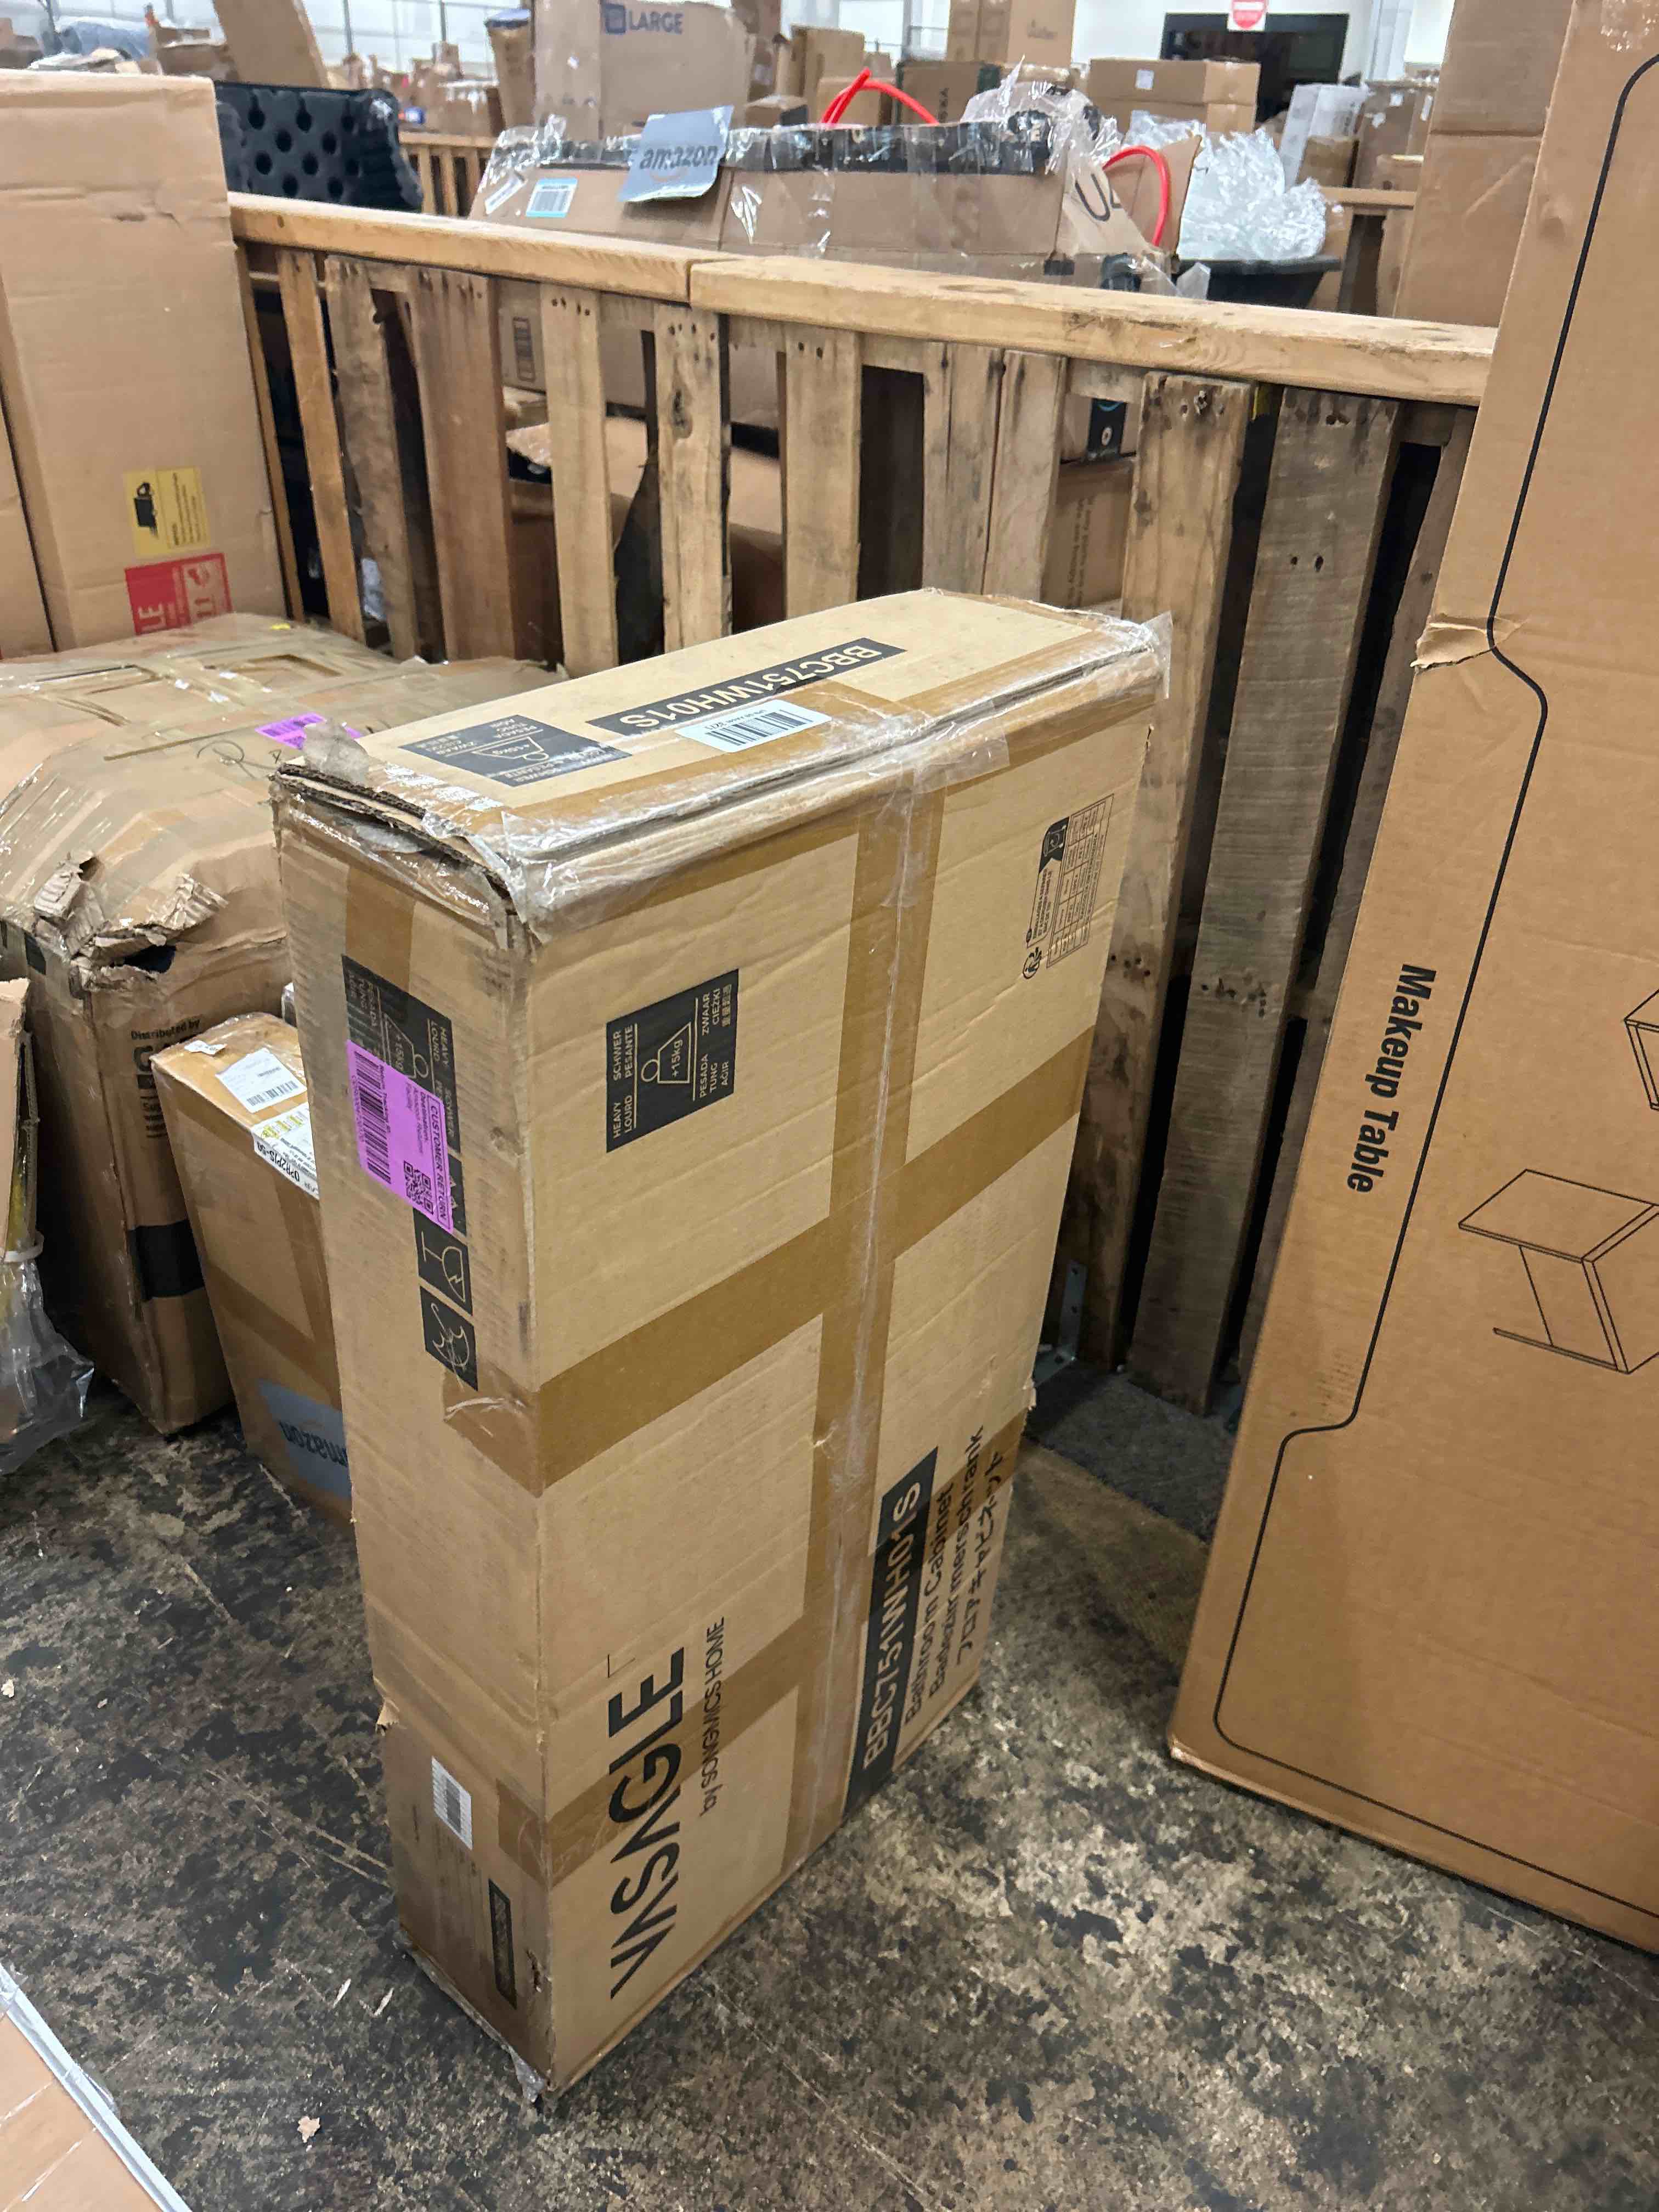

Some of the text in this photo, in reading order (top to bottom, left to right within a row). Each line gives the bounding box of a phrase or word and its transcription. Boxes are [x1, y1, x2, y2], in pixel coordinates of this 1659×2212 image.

[630, 10, 684, 35] LARGE
[640, 145, 719, 170] amazon
[620, 645, 882, 729] BBC751WH01S
[613, 1030, 623, 1138] HEAVY SCHWER
[624, 1025, 633, 1133] LOURD PESANTE
[672, 1039, 684, 1077] +15kg
[699, 991, 710, 1098] PESADA ZWAAR
[710, 1062, 719, 1093] TUNG
[1347, 963, 1437, 1193] Makeup Table
[430, 1105, 445, 1171] CUSTOMER
[437, 1173, 448, 1221] RETURN
[279, 1420, 348, 1468] mazon
[862, 1481, 921, 1770] BBC751WH01S
[904, 1482, 954, 1725] Bathroom Cabinet
[699, 1616, 725, 1818] by SONGMICS HOME
